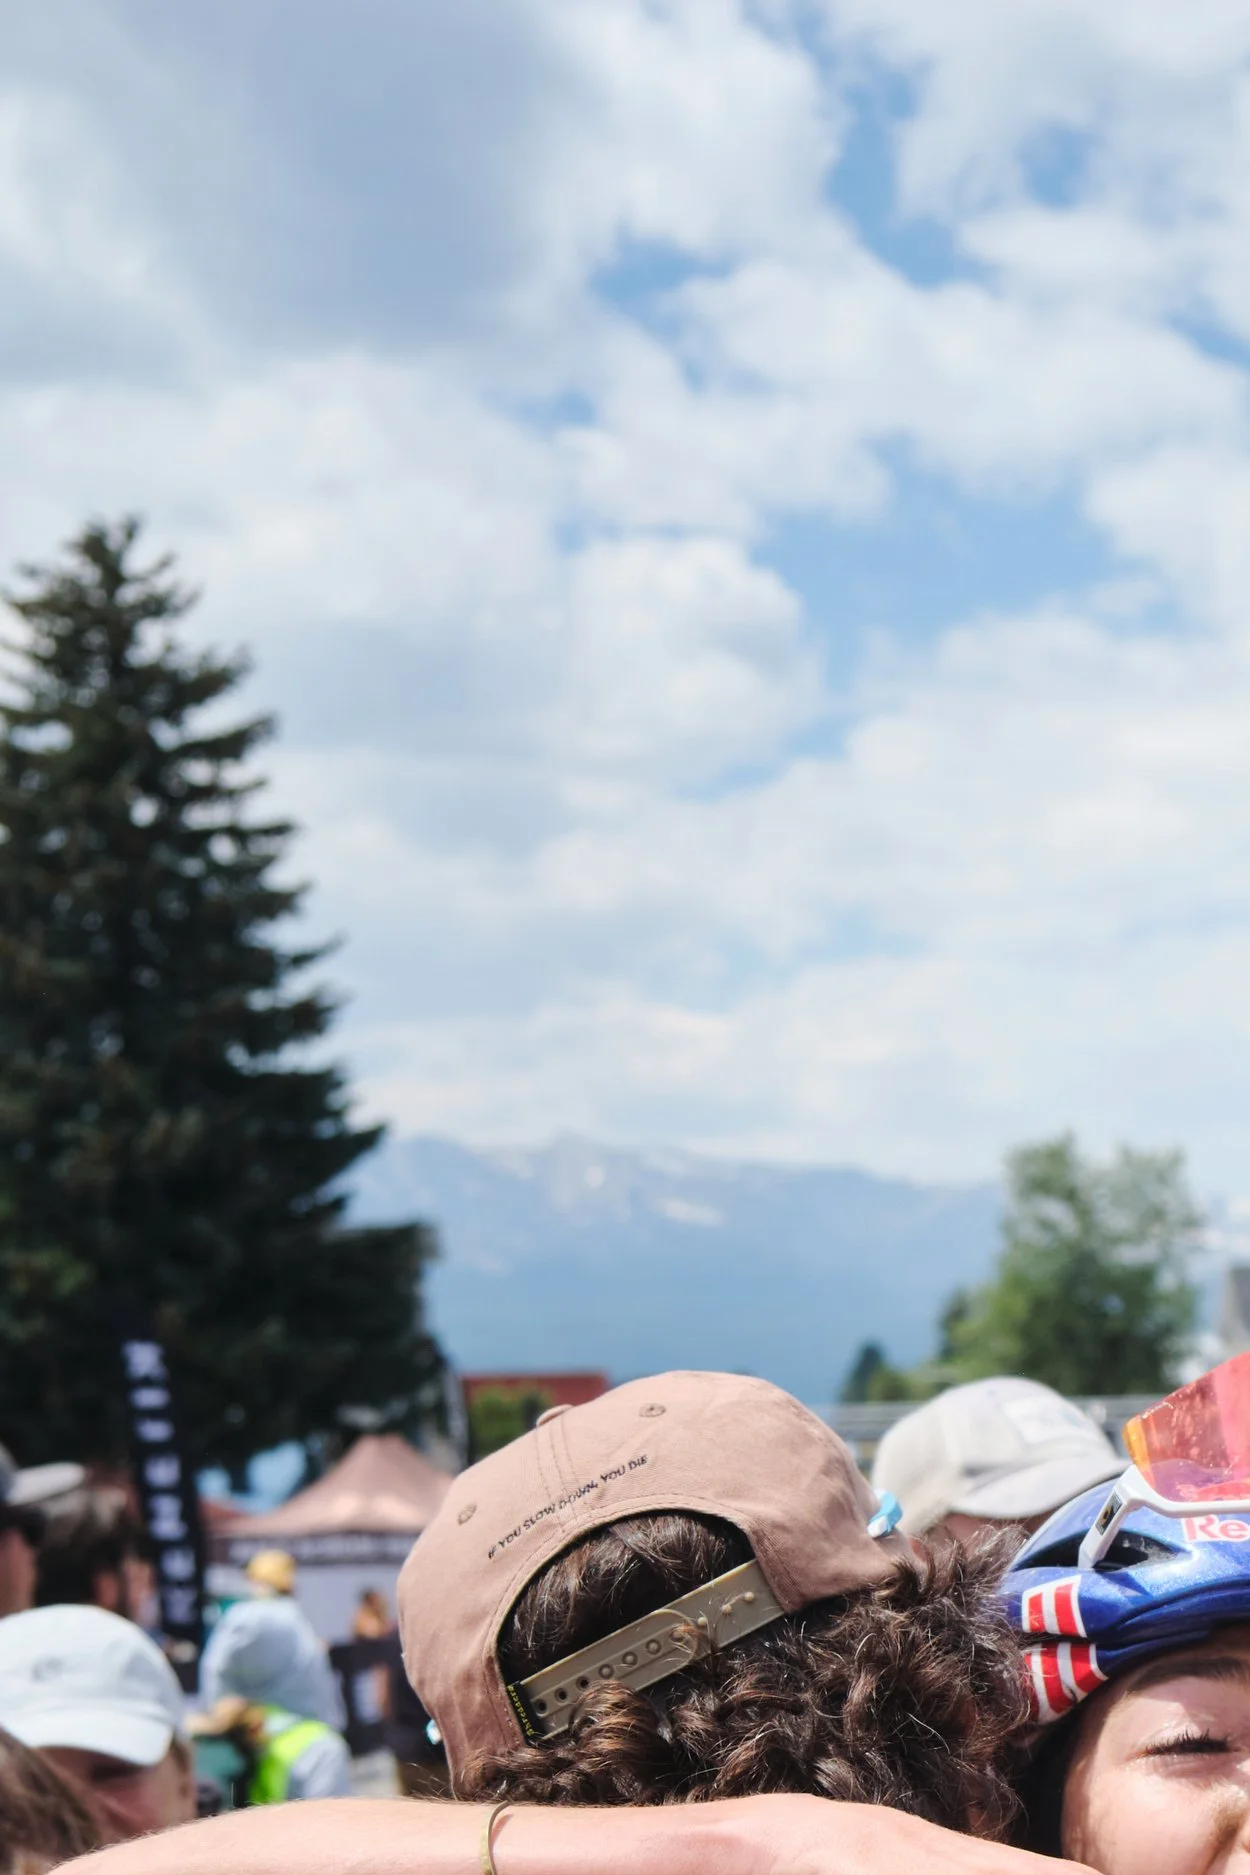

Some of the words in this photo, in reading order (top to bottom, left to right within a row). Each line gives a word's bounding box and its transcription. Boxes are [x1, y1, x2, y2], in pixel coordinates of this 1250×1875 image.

[499, 1528, 521, 1549] YOU
[523, 1504, 556, 1532] SLOW
[600, 1466, 626, 1483] YOU
[628, 1454, 648, 1471] DIE
